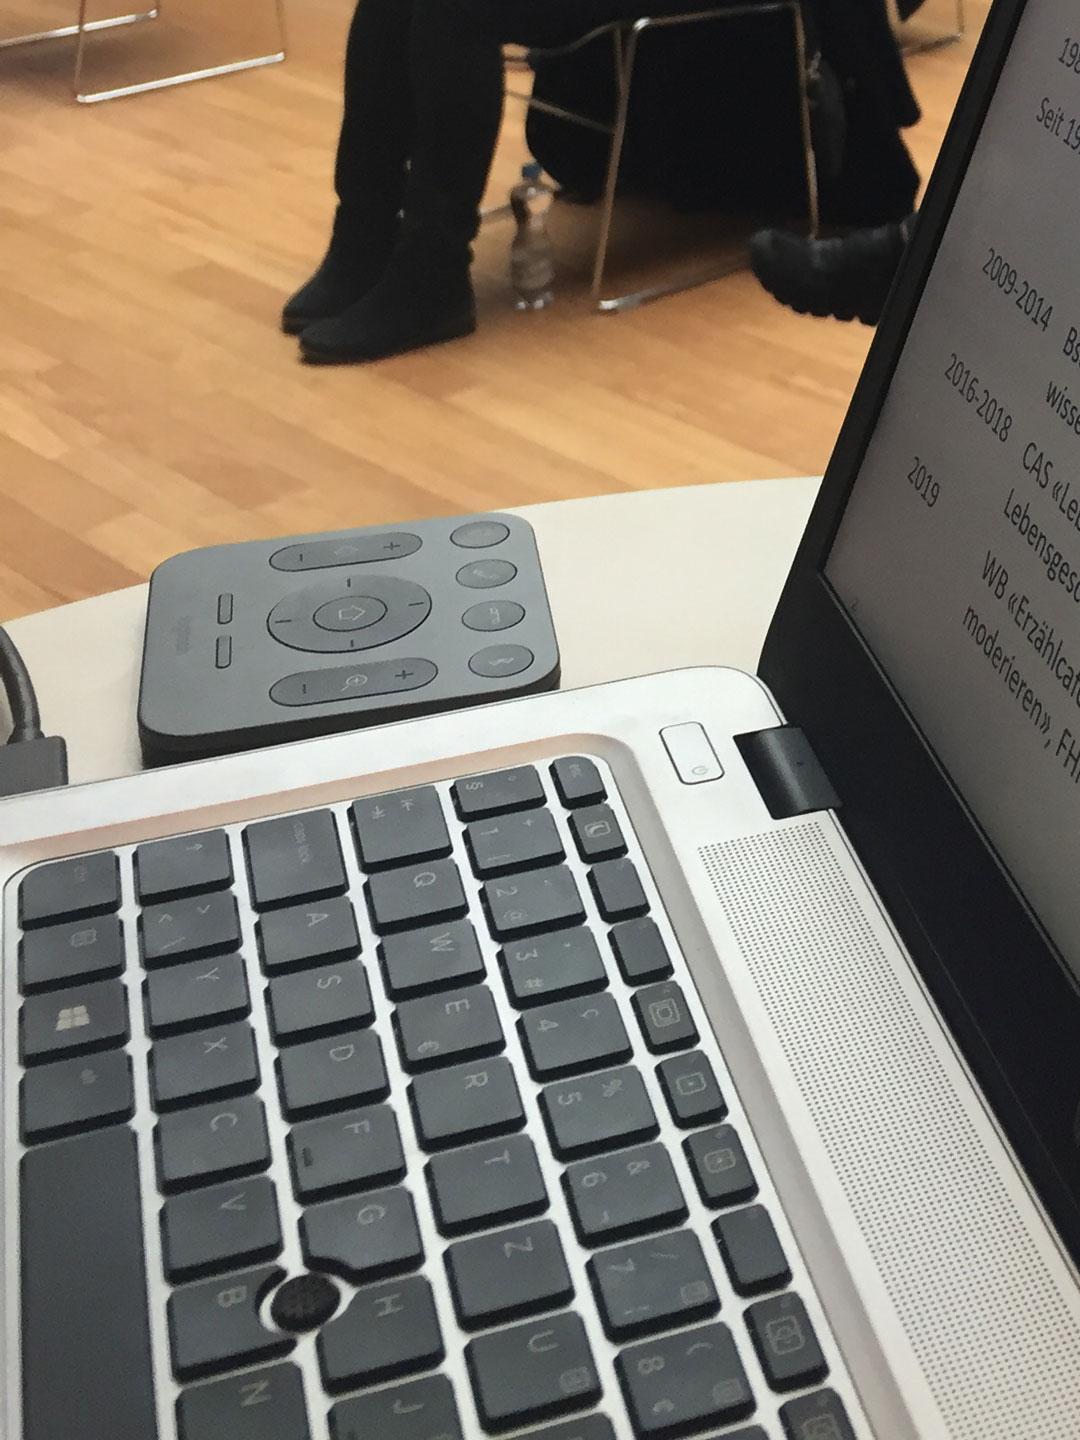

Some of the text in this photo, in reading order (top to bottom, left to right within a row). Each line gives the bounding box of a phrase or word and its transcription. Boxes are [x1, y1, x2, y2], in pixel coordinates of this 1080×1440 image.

[1036, 97, 1064, 136] Seit
[982, 248, 1053, 332] 2009-2014
[944, 353, 1013, 442] 2016-2018
[1023, 442, 1053, 489] CAS
[907, 456, 939, 507] 2019
[981, 550, 1009, 601] WB
[963, 605, 1052, 749] moderieren»,
[413, 871, 437, 888] Q
[305, 912, 330, 928] A
[429, 932, 455, 952] W
[196, 967, 220, 981] Y
[316, 974, 342, 990] S
[445, 999, 469, 1015] E
[203, 1037, 228, 1054] X
[329, 1044, 355, 1062] D
[464, 1072, 488, 1089] R
[557, 1091, 582, 1106] 5
[210, 1112, 238, 1131] C
[343, 1119, 371, 1134] F
[484, 1150, 510, 1165] T
[581, 1171, 606, 1188] 6
[220, 1192, 247, 1211] V
[357, 1204, 385, 1225] G
[504, 1237, 533, 1258] Z
[217, 1285, 247, 1308] B
[374, 1294, 403, 1317] H
[527, 1329, 558, 1353] U
[638, 1356, 665, 1375] 8
[239, 1379, 272, 1408] N
[393, 1399, 424, 1414] J
